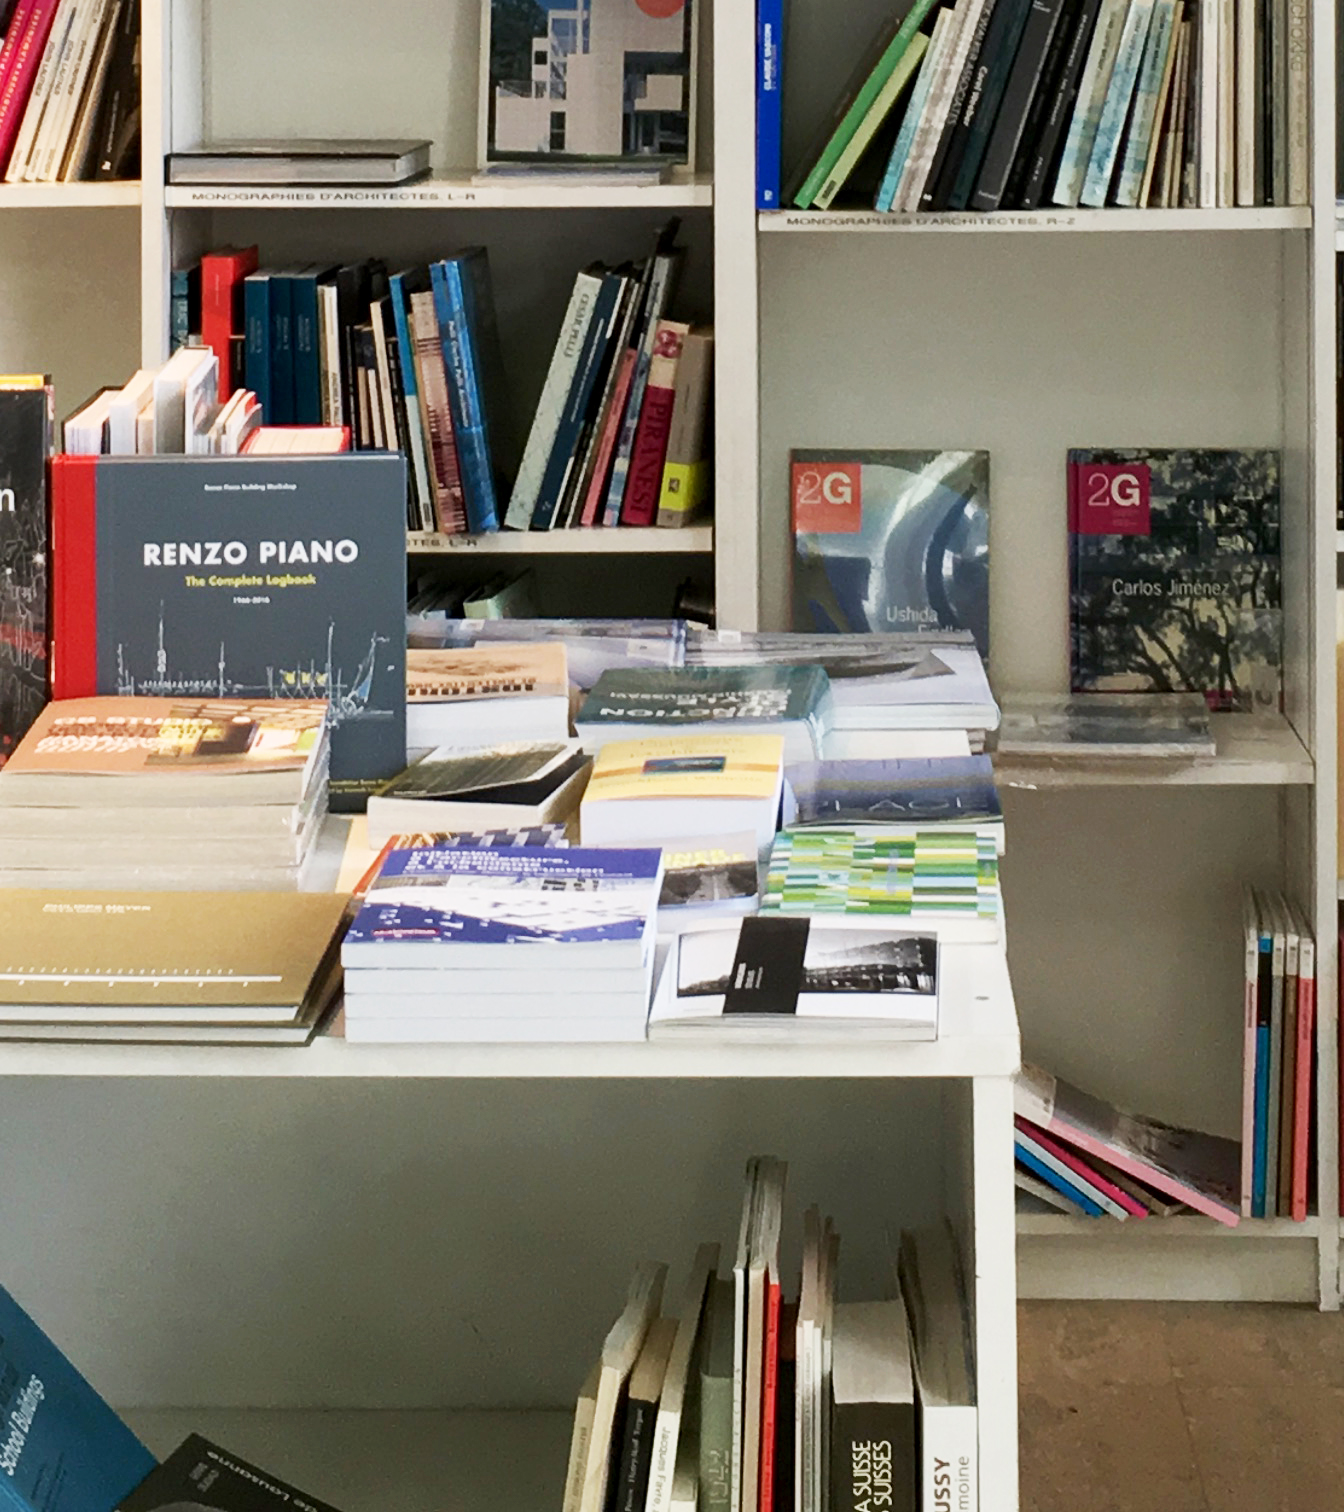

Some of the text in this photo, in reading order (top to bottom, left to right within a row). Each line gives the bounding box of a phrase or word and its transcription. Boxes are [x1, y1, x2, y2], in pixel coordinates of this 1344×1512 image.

[797, 471, 853, 505] 2G
[1087, 472, 1141, 507] 2G
[142, 539, 359, 566] RENZO PIANO
[184, 574, 317, 588] The Complete Logbook
[1112, 578, 1230, 597] Carlos Jiménez
[885, 607, 939, 623] Ushida
[11, 1374, 45, 1435] Buildings
[850, 1439, 872, 1498] SUISSE
[872, 1439, 893, 1506] SUISSES
